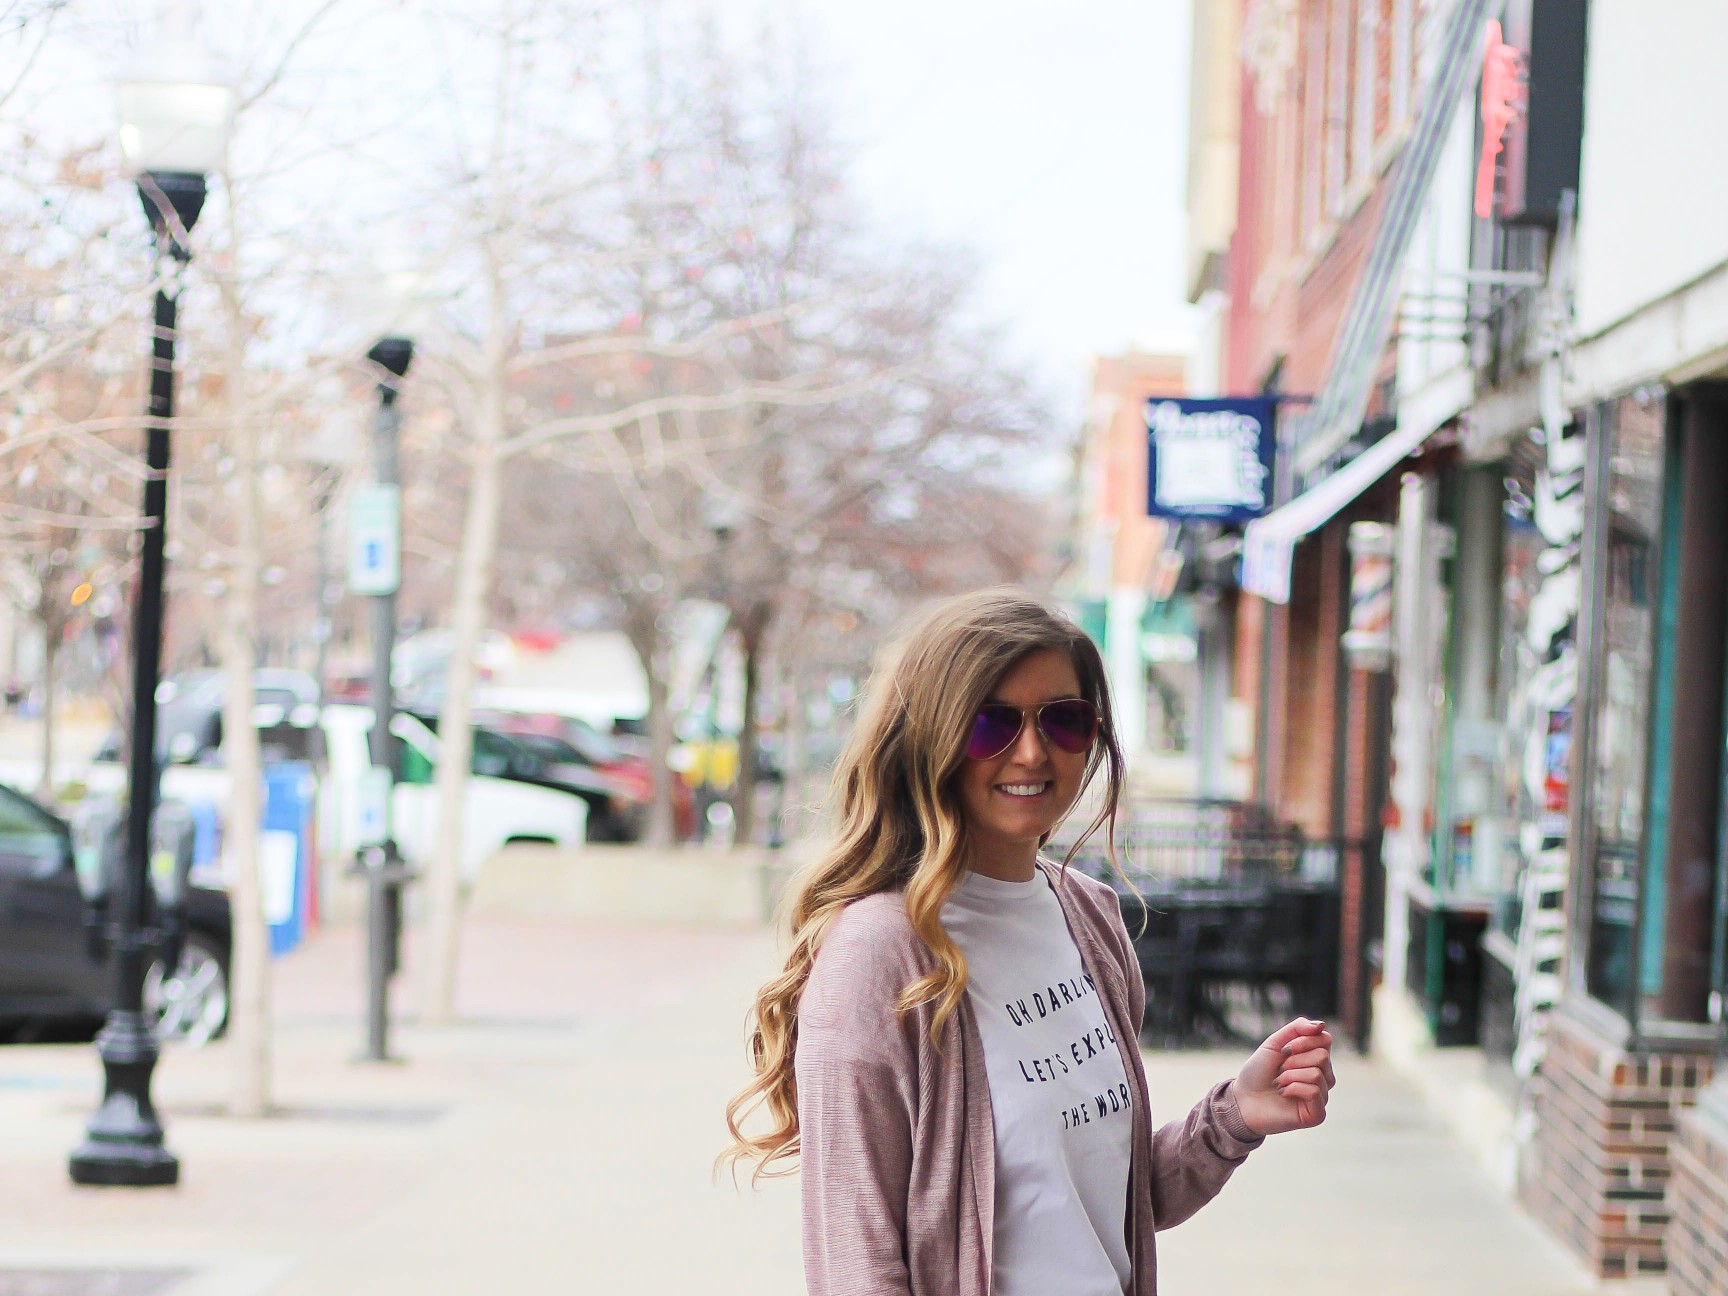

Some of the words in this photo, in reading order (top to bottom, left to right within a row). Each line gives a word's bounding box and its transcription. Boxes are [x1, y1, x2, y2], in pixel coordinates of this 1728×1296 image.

[1005, 999, 1033, 1026] OH
[1018, 1054, 1068, 1082] LET'S
[1062, 1103, 1090, 1129] THE
[1095, 1083, 1131, 1117] WOR
